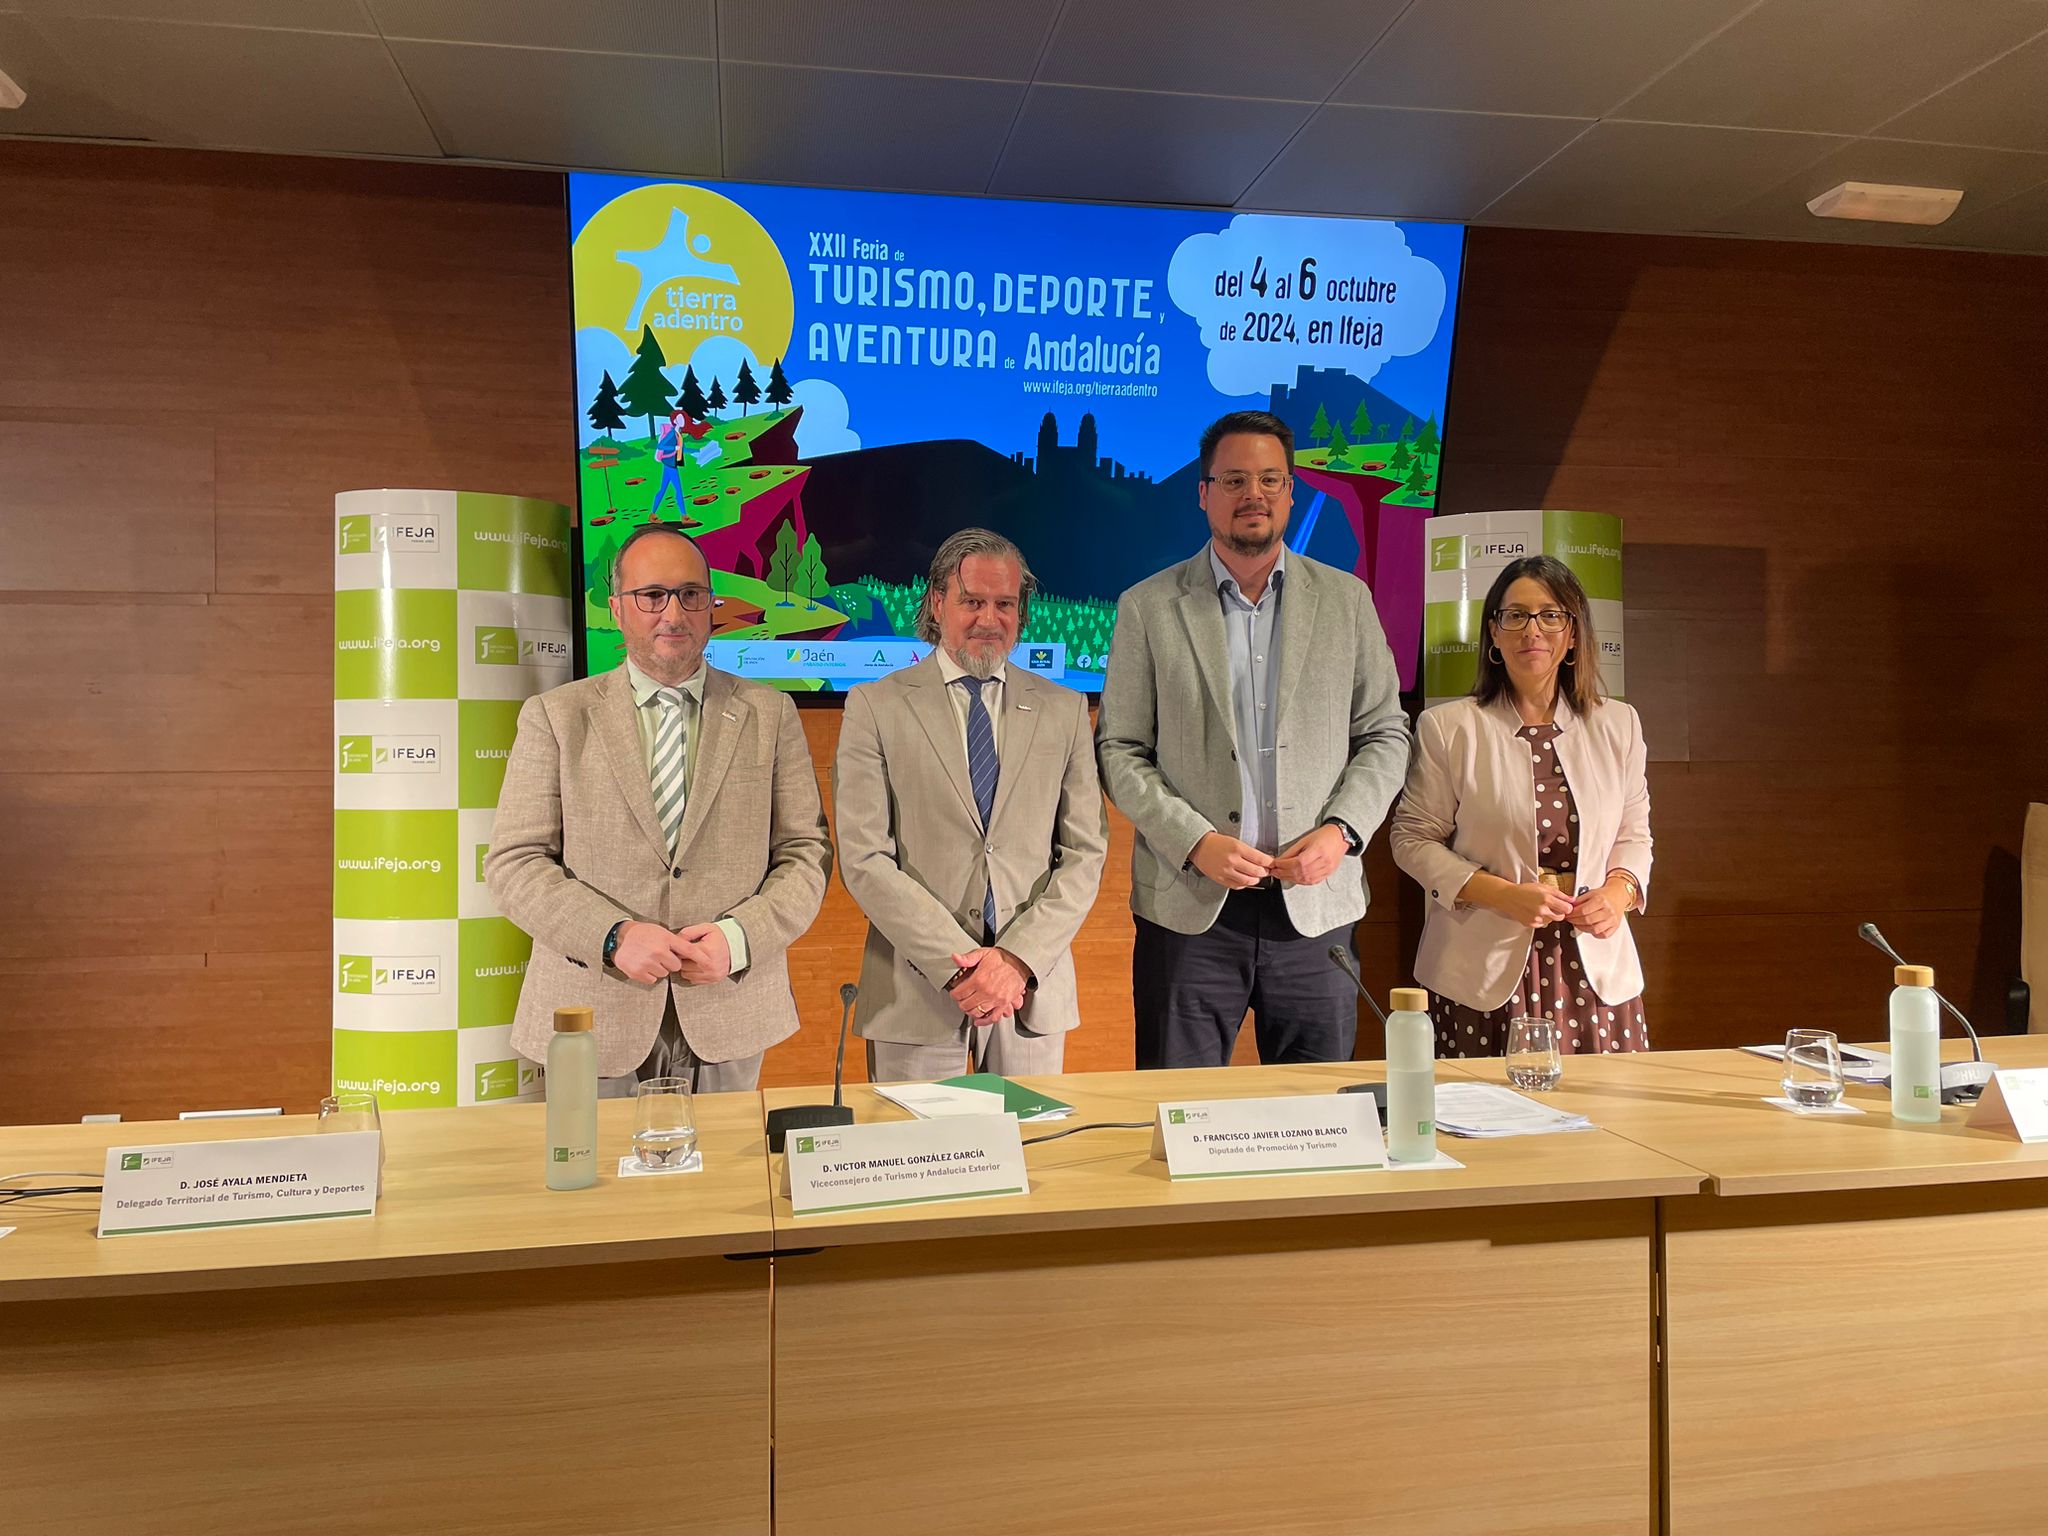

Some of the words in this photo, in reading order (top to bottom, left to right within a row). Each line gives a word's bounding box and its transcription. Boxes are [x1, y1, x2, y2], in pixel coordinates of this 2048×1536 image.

[808, 231, 846, 258] XXII
[853, 238, 889, 261] Feria
[894, 249, 905, 262] de
[1214, 270, 1244, 298] del
[1250, 255, 1268, 299] 4
[1275, 272, 1292, 299] al
[1298, 257, 1317, 301] 6
[1326, 276, 1397, 304] octubre
[666, 286, 736, 311] tierra
[808, 264, 986, 317] TURISMO,
[993, 272, 1154, 319] DEPORTE
[1158, 312, 1165, 325] y
[653, 308, 744, 332] adentro
[1219, 321, 1236, 341] de
[1242, 311, 1300, 346] 2024,
[1308, 319, 1333, 345] en
[1339, 315, 1383, 350] Ifeja
[808, 322, 997, 369] AVENTURA
[1004, 357, 1015, 370] de
[1023, 331, 1161, 375] Andalucía
[1022, 380, 1158, 398] www.ifeja.org/tierraadentro
[392, 527, 435, 538] IFEJA
[1485, 543, 1524, 555] IFEJA
[537, 641, 567, 654] IFEJA
[802, 648, 835, 662] Jaén
[1601, 642, 1621, 653] IFEJA
[392, 748, 436, 759] IFEJA
[338, 856, 441, 873] www.ifeja.org
[392, 968, 436, 980] IFEJA
[337, 1078, 441, 1096] www.ifeja.org
[1193, 1135, 1202, 1143] D.
[1203, 1132, 1250, 1142] FRANCISCO
[1252, 1130, 1280, 1140] JAVIER
[1281, 1128, 1313, 1138] LOZANO
[1314, 1127, 1348, 1136] BLANCO
[1208, 1146, 1244, 1156] Diputado
[1256, 1143, 1299, 1153] Promoción
[1306, 1141, 1338, 1150] Turismo
[822, 1165, 833, 1173] D.
[834, 1161, 867, 1172] VICTOR
[868, 1157, 906, 1168] MANUEL
[907, 1152, 952, 1165] GONZÁLEZ
[953, 1148, 985, 1160] GARCÍA
[179, 1180, 190, 1190] D.
[193, 1177, 219, 1189] JOSÉ
[221, 1177, 253, 1187] AYALA
[255, 1173, 308, 1185] MENDIETA
[810, 1176, 871, 1189] Viceconsejero
[872, 1174, 883, 1182] de
[885, 1171, 918, 1181] Turismo
[919, 1171, 925, 1180] y
[968, 1163, 1001, 1173] Exterior
[116, 1198, 164, 1210] Delegado
[166, 1194, 216, 1206] Territorial
[217, 1193, 230, 1202] de
[232, 1190, 274, 1202] Turismo,
[276, 1188, 312, 1198] Cultura
[313, 1188, 321, 1197] y
[322, 1184, 365, 1195] Deportes
